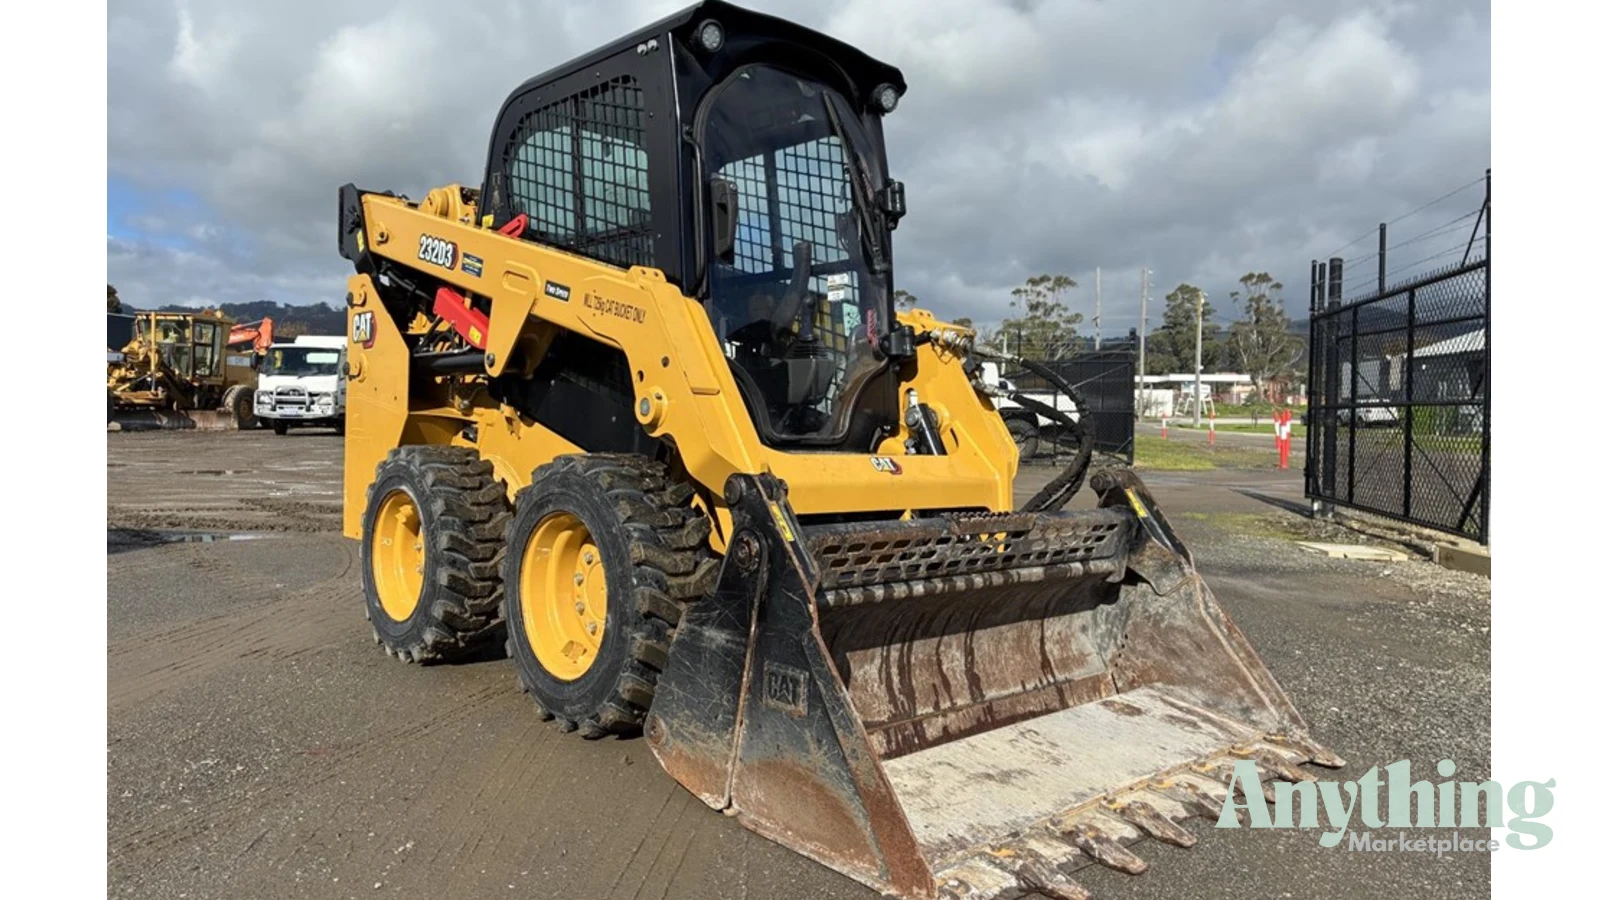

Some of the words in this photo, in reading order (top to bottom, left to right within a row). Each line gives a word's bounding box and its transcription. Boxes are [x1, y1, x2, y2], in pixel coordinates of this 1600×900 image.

[418, 235, 454, 269] 232D3
[353, 312, 373, 342] CAT
[614, 302, 634, 320] BUCKET
[632, 307, 646, 324] ONLY
[870, 457, 896, 472] CAT
[768, 671, 801, 707] CAT
